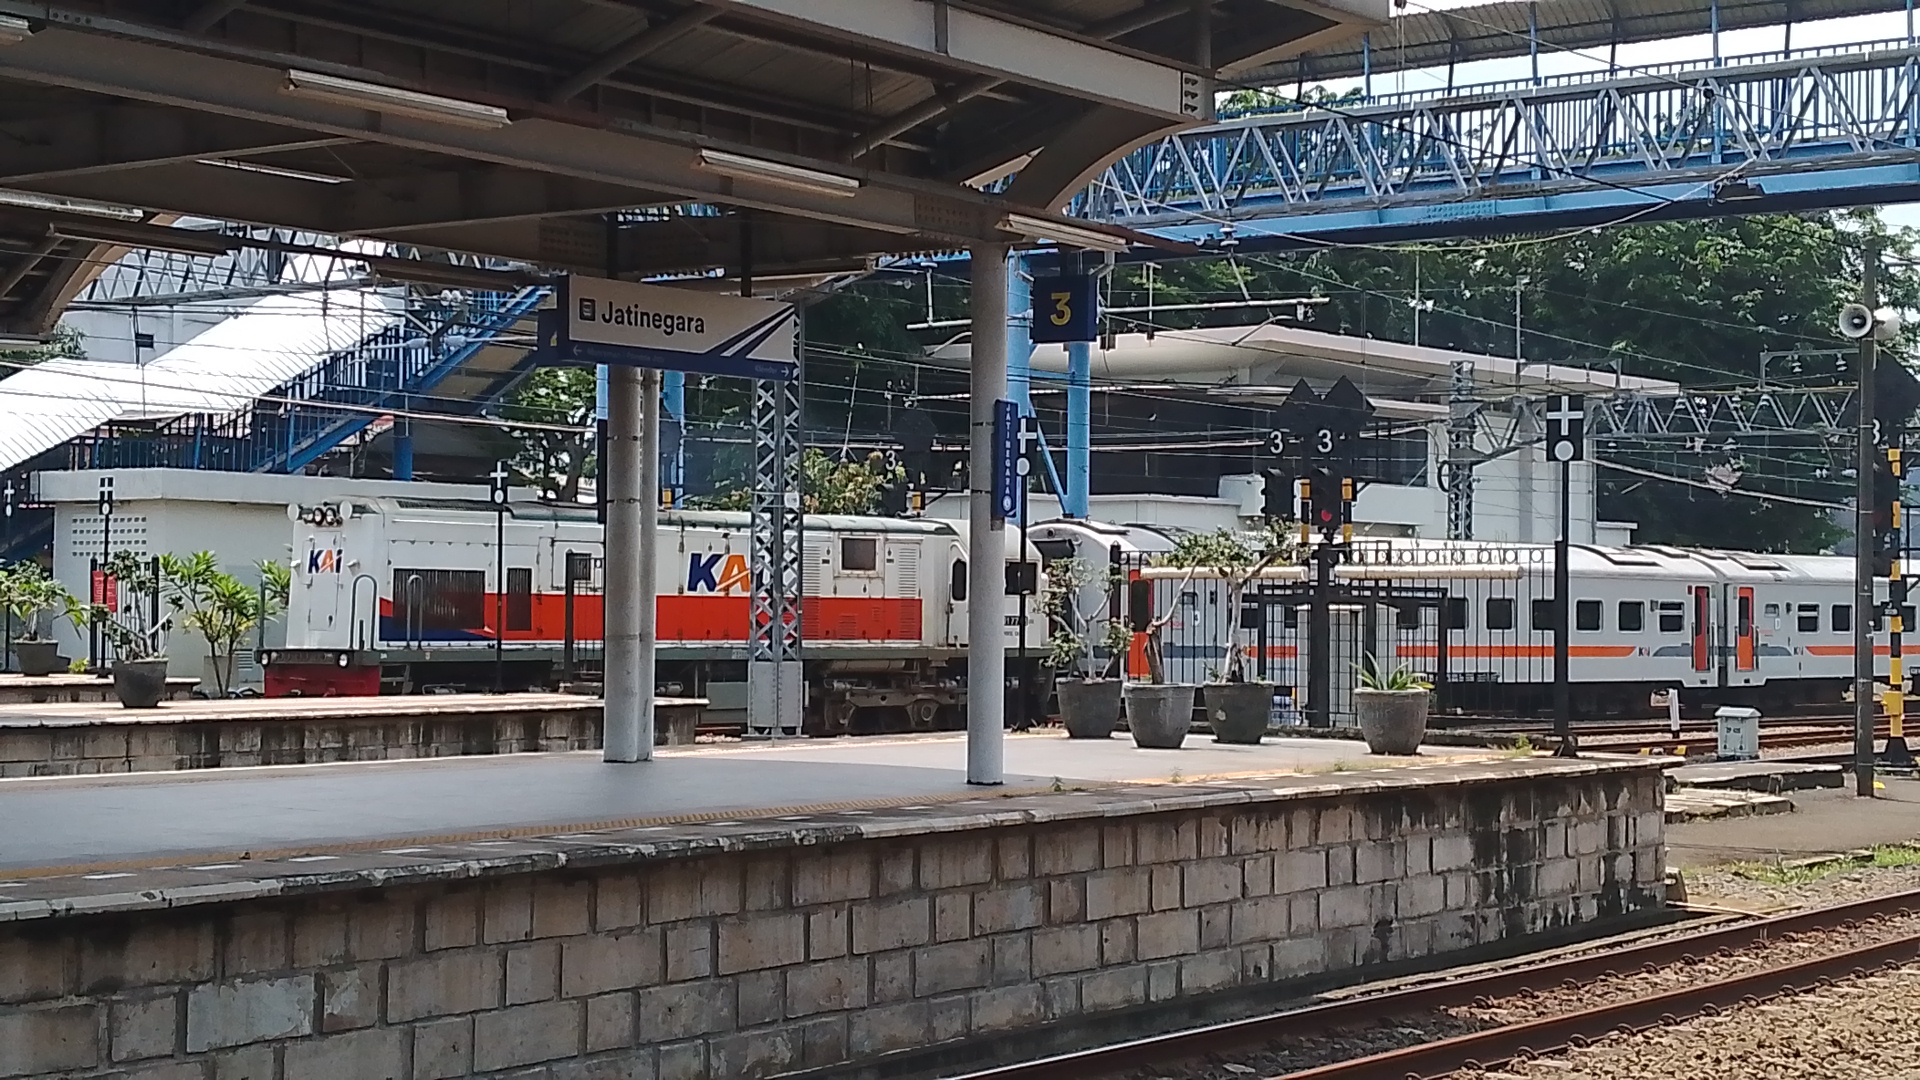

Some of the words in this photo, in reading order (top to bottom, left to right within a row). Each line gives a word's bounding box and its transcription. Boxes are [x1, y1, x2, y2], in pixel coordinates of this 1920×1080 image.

[602, 301, 705, 336] Jatinegara
[1050, 292, 1071, 325] 3
[1270, 430, 1284, 454] 3
[1317, 429, 1333, 453] 3
[885, 450, 896, 470] 3
